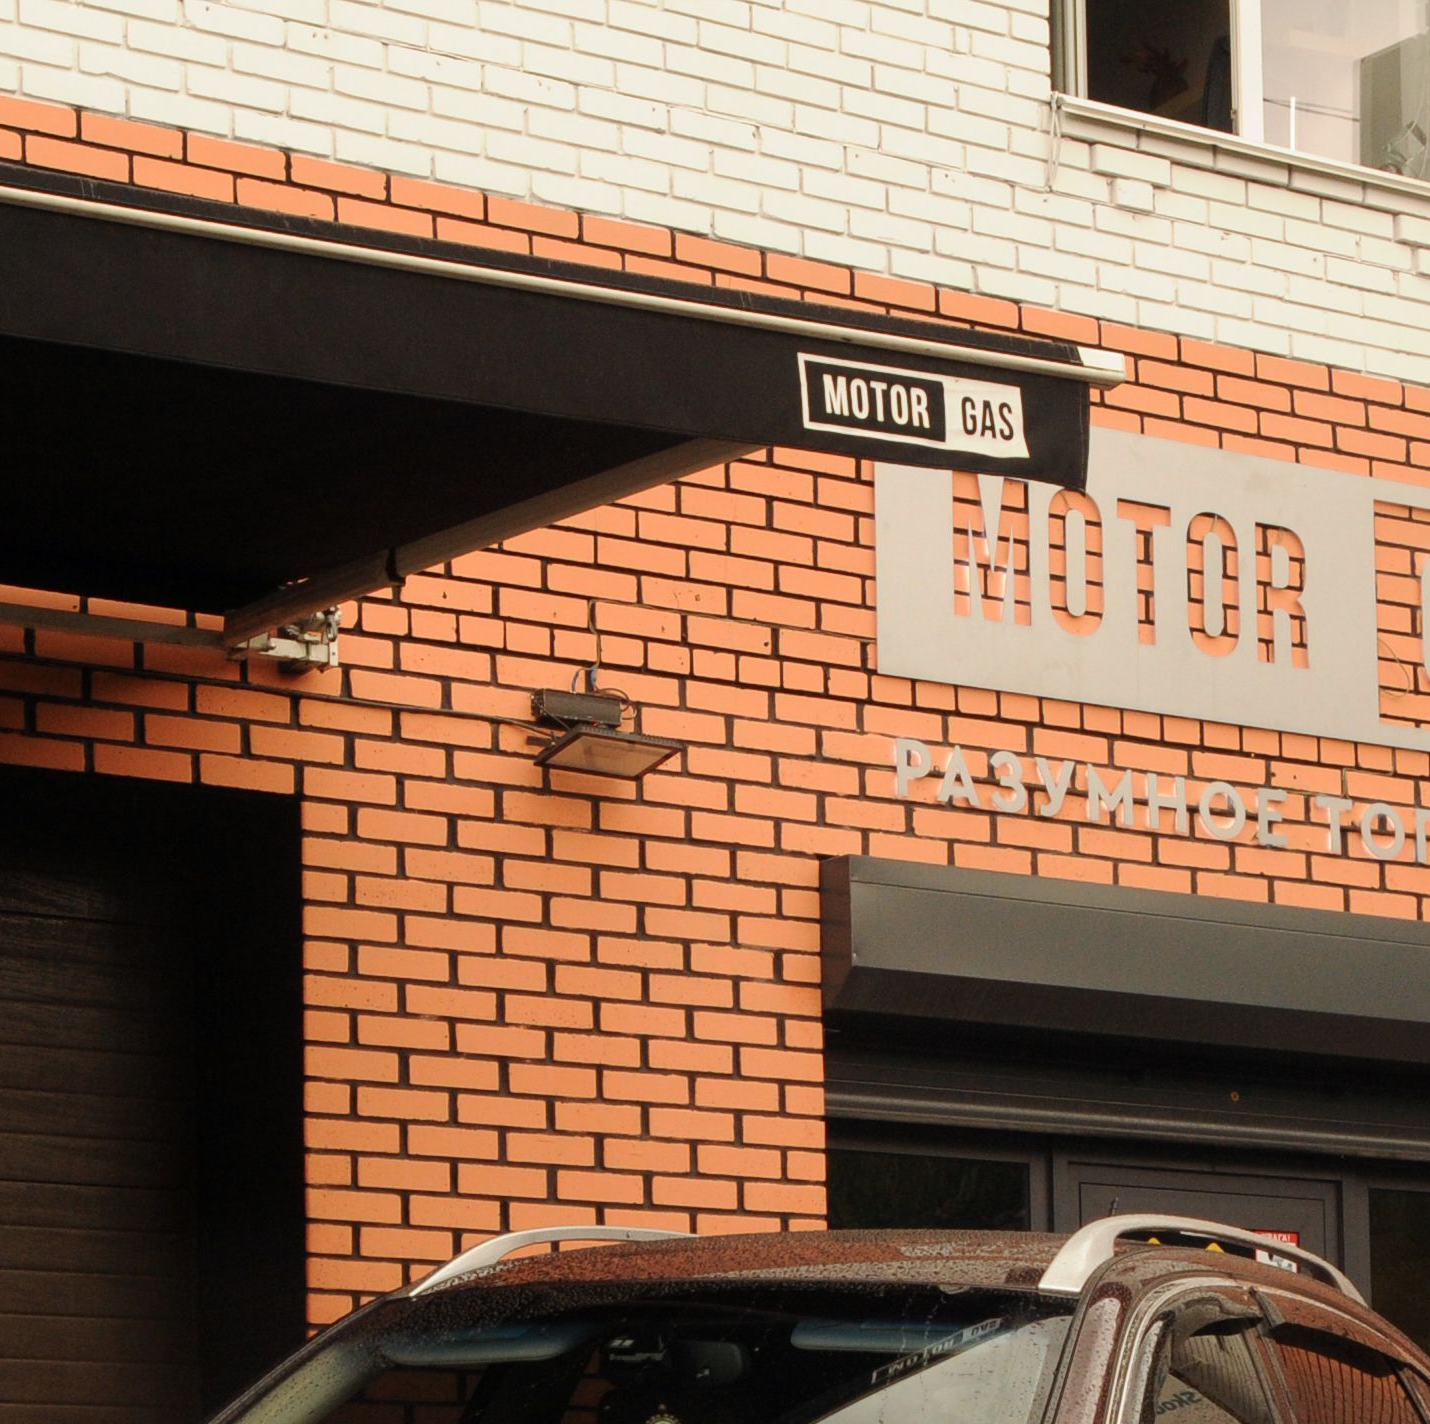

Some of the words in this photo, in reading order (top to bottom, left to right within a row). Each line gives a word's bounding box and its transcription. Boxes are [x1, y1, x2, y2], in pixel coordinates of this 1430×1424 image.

[822, 373, 931, 429] MOTOR
[961, 396, 1015, 441] GAS
[953, 471, 1310, 669] MOTOR
[895, 738, 1288, 850] РАЗУМНОЕ
